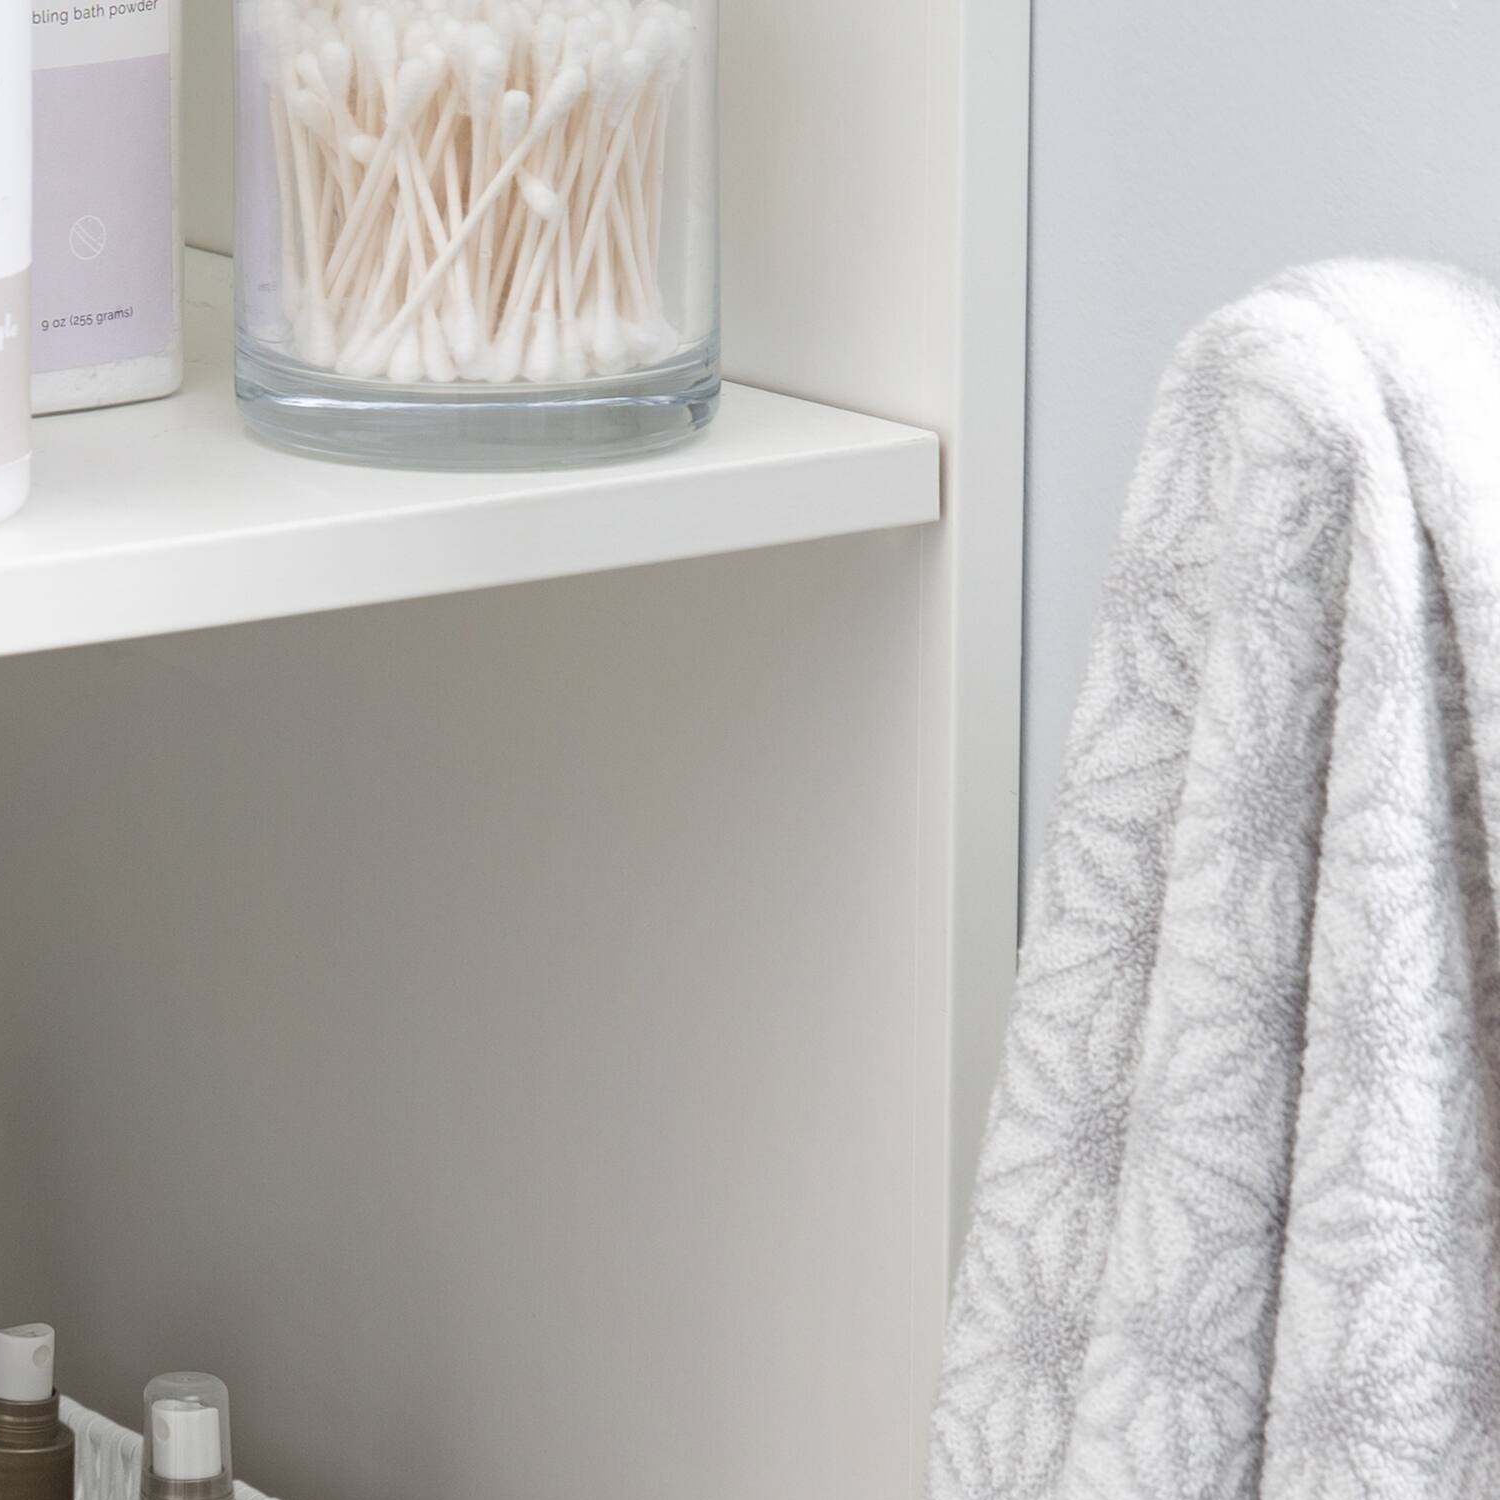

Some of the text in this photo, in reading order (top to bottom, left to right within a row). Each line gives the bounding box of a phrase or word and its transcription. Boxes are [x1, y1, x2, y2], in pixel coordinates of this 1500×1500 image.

[73, 4, 105, 21] bath
[109, 0, 158, 19] powder
[41, 306, 134, 332] 9 oz (255 grams)
